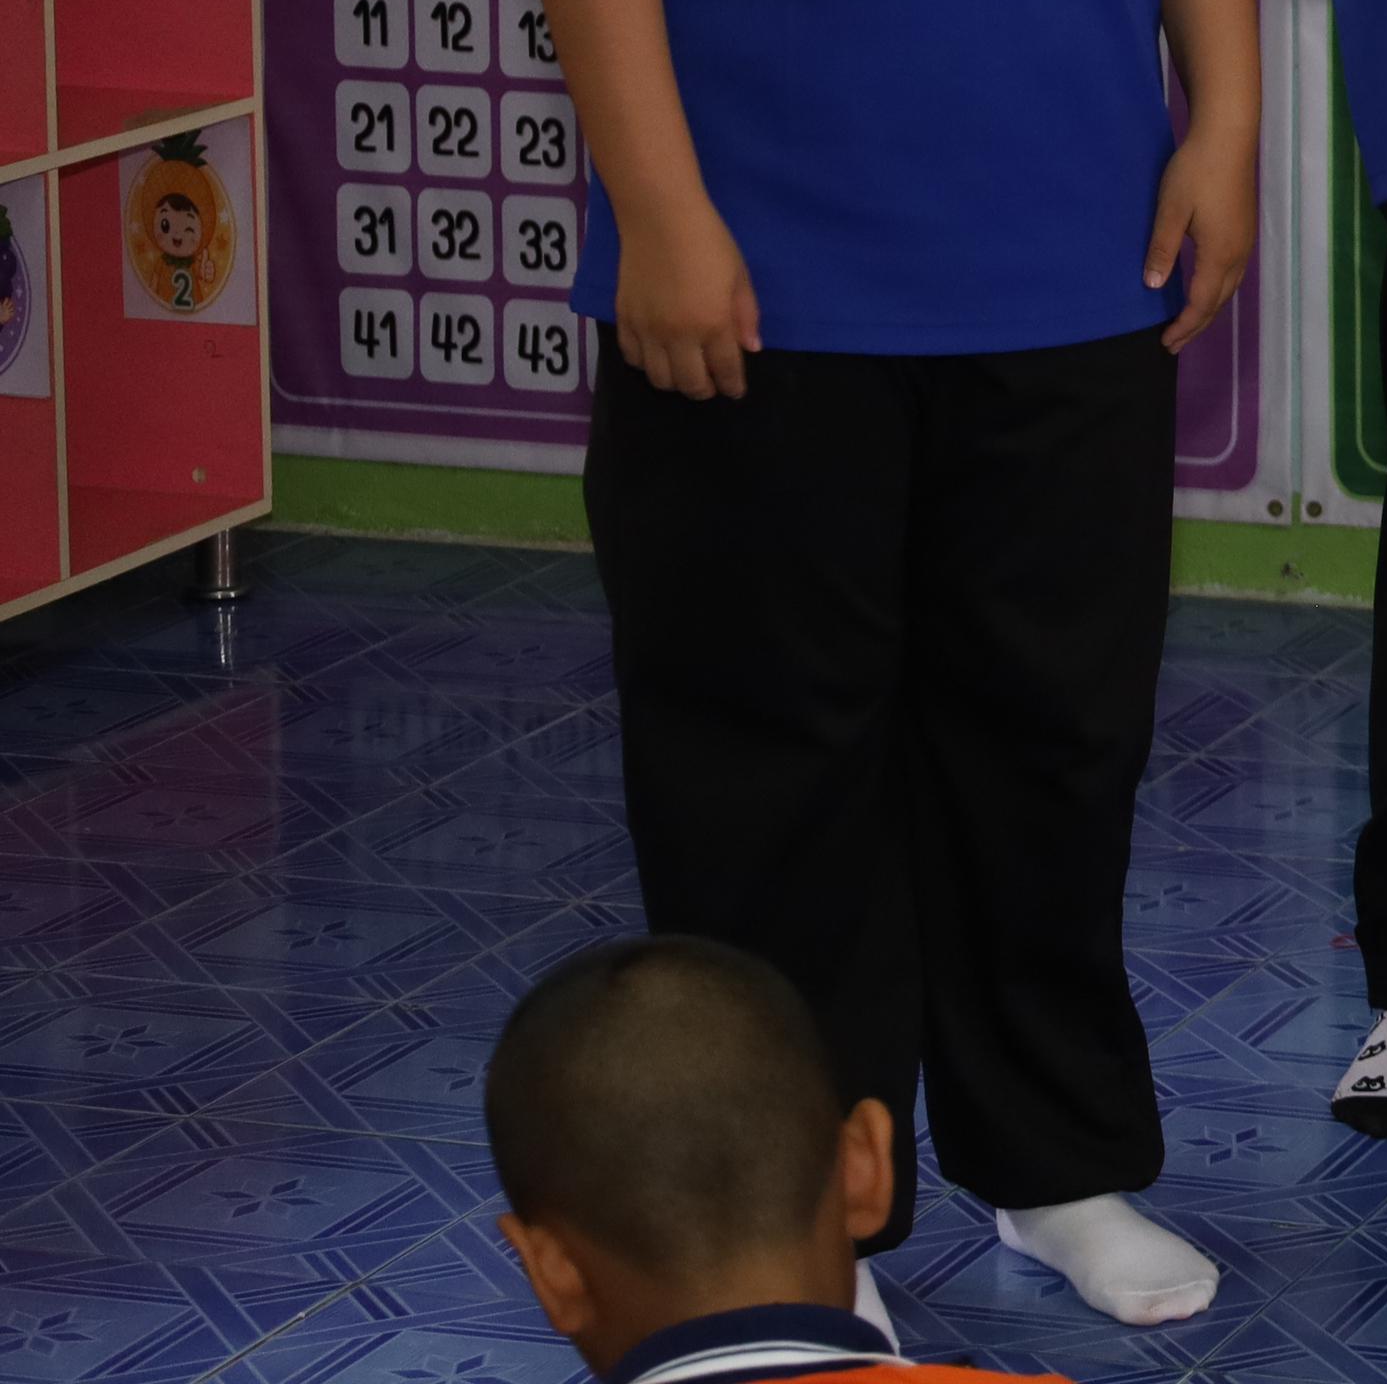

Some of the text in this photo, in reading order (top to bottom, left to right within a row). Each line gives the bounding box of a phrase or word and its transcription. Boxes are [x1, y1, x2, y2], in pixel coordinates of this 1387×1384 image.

[430, 0, 474, 52] 12
[518, 9, 559, 63] 13
[350, 102, 566, 168] 21 22 23
[353, 205, 568, 271] 31 32 33
[172, 270, 194, 309] 2
[353, 308, 570, 375] 41 42 43
